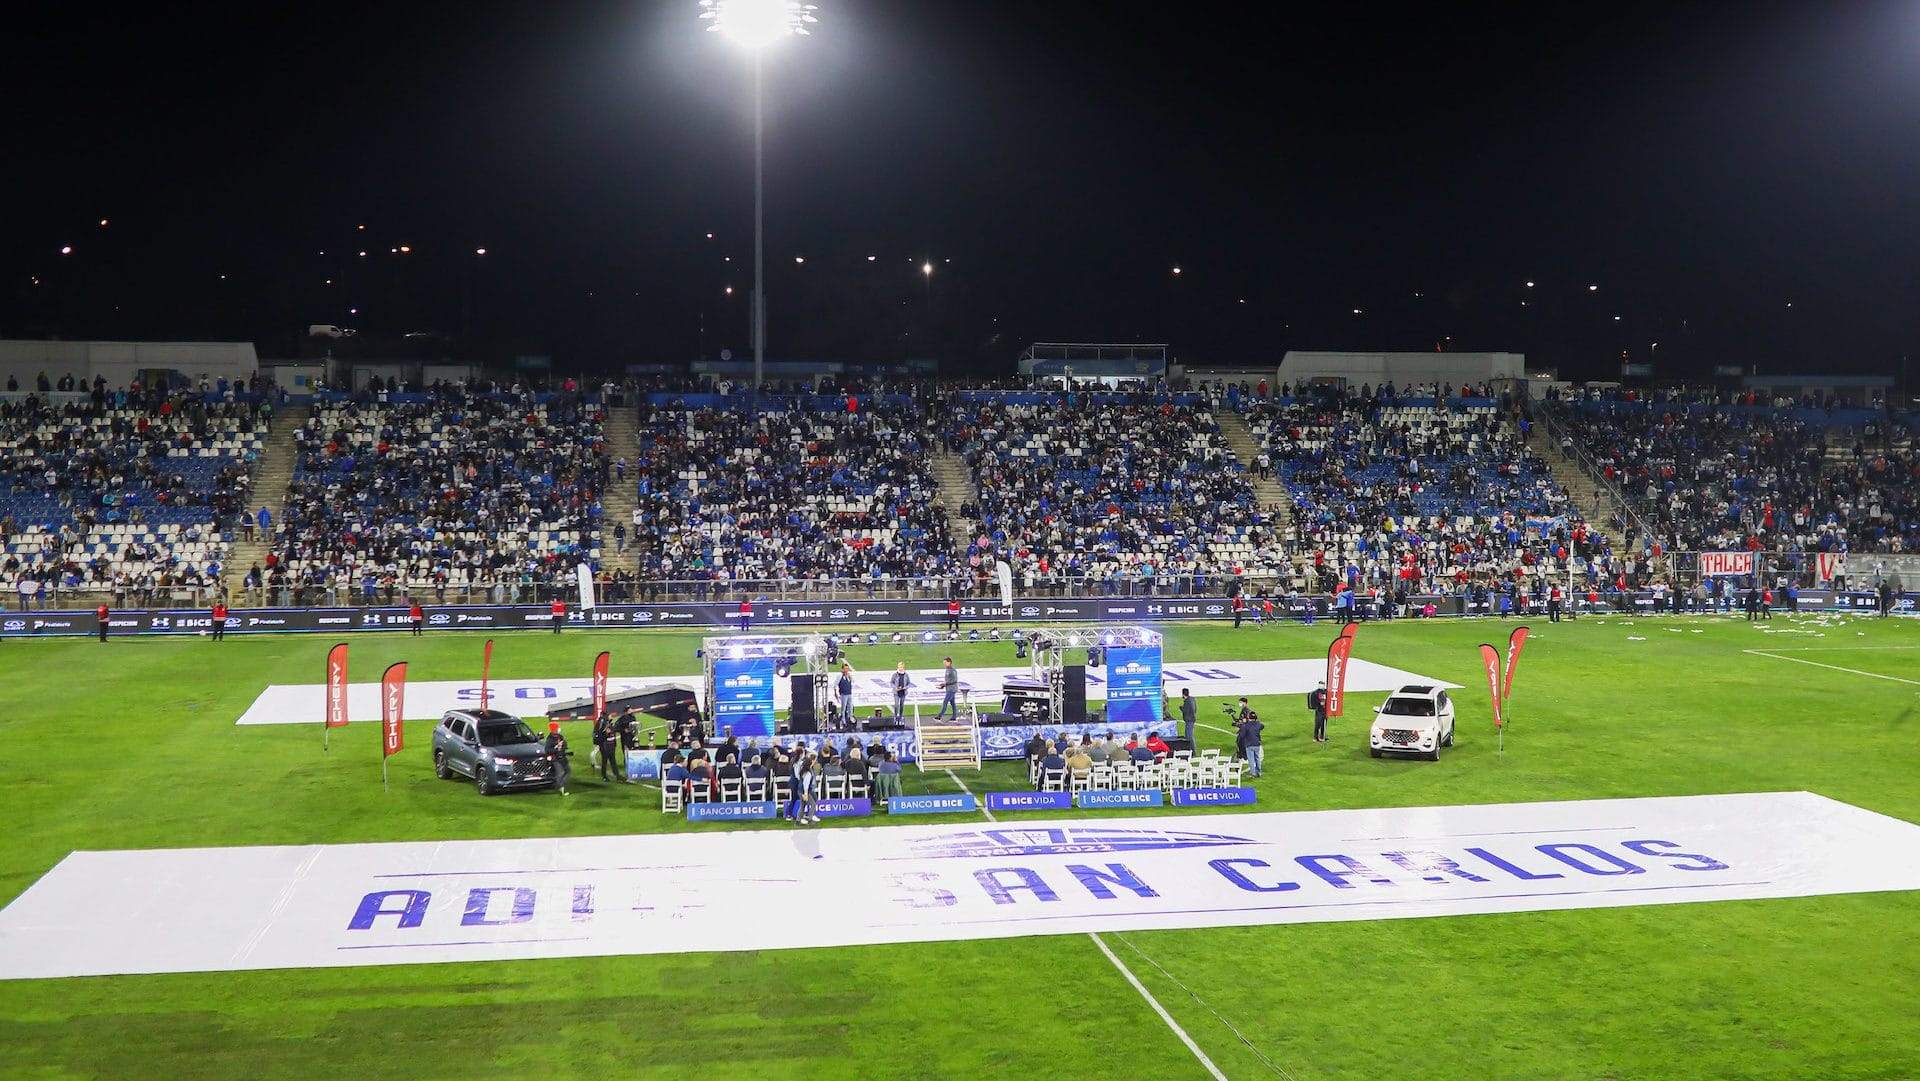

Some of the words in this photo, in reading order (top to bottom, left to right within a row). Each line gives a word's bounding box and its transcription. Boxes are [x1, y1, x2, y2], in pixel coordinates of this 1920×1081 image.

[1703, 553, 1752, 573] TALCA
[187, 619, 211, 627] BICE
[1330, 653, 1343, 712] CHERY
[332, 662, 344, 723] CHERY
[388, 682, 401, 750] CHERY
[888, 742, 920, 758] BIC
[984, 749, 1023, 757] CHERY
[1011, 797, 1033, 805] BICE
[1034, 796, 1056, 804] VIDA
[1090, 795, 1122, 803] BANCO
[1130, 794, 1151, 802] BICE
[1197, 792, 1218, 801] BICE
[1219, 792, 1241, 800] VIDA
[815, 804, 831, 812] ICE
[833, 803, 855, 811] VIDA
[900, 801, 933, 809] BANCO
[942, 799, 963, 807] BICE
[700, 807, 733, 816] BANCO
[742, 806, 764, 814] BICE
[1207, 839, 1730, 893] CARLOS
